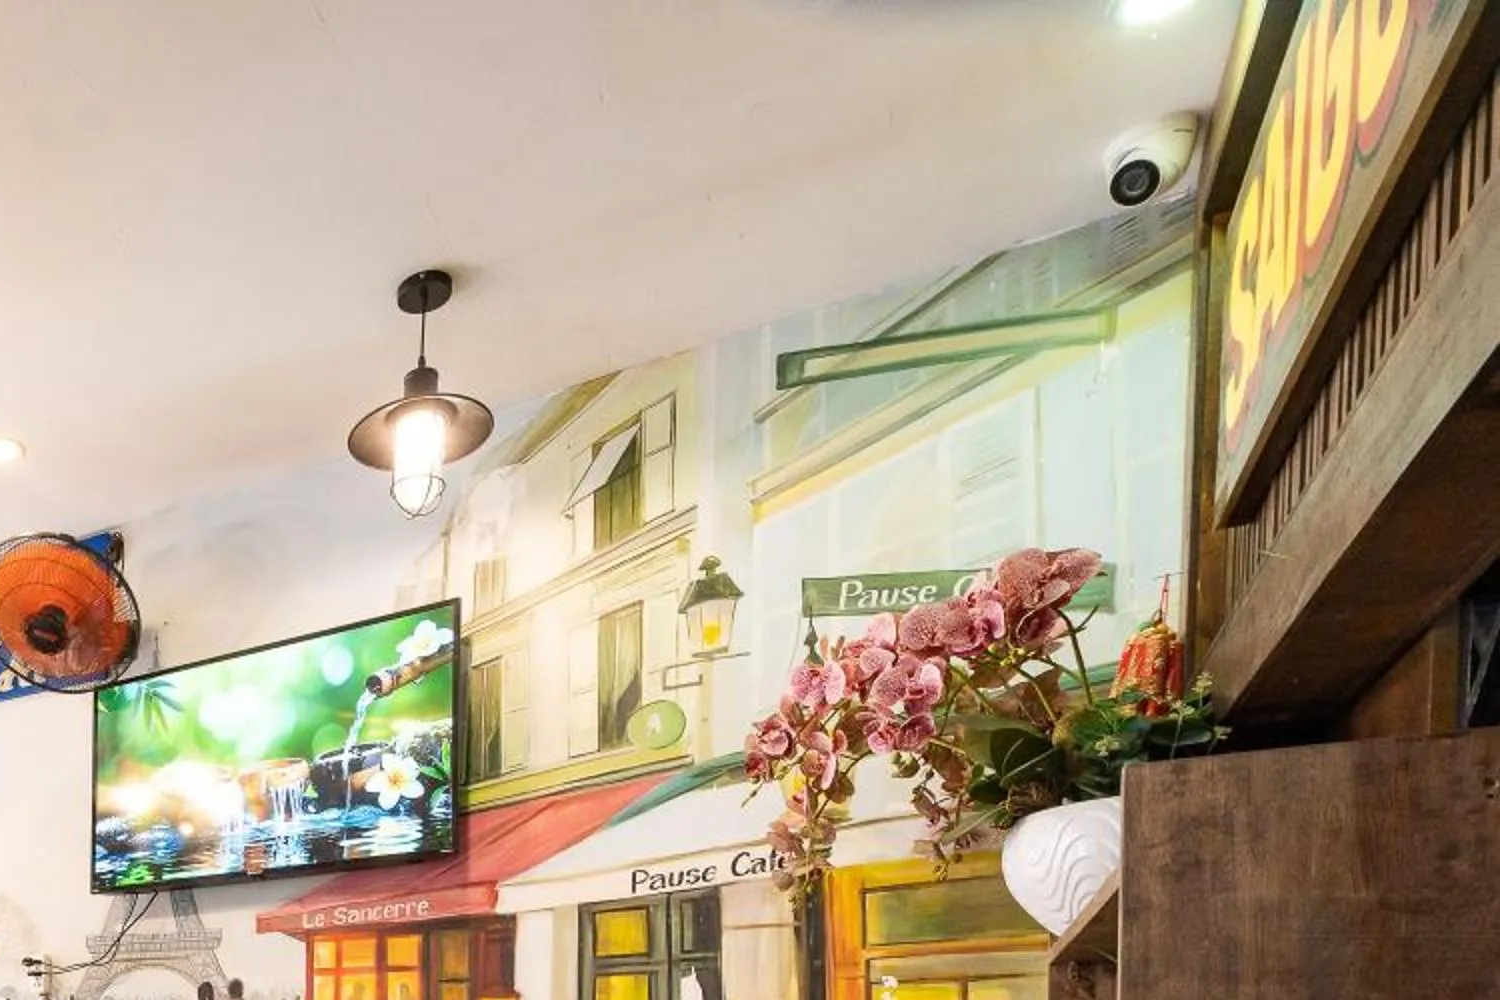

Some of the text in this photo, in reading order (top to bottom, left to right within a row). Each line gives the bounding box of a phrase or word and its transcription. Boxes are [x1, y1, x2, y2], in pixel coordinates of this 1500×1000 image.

[838, 579, 938, 611] Pause
[631, 863, 718, 894] Pause
[302, 898, 430, 930] Le Sancerre
